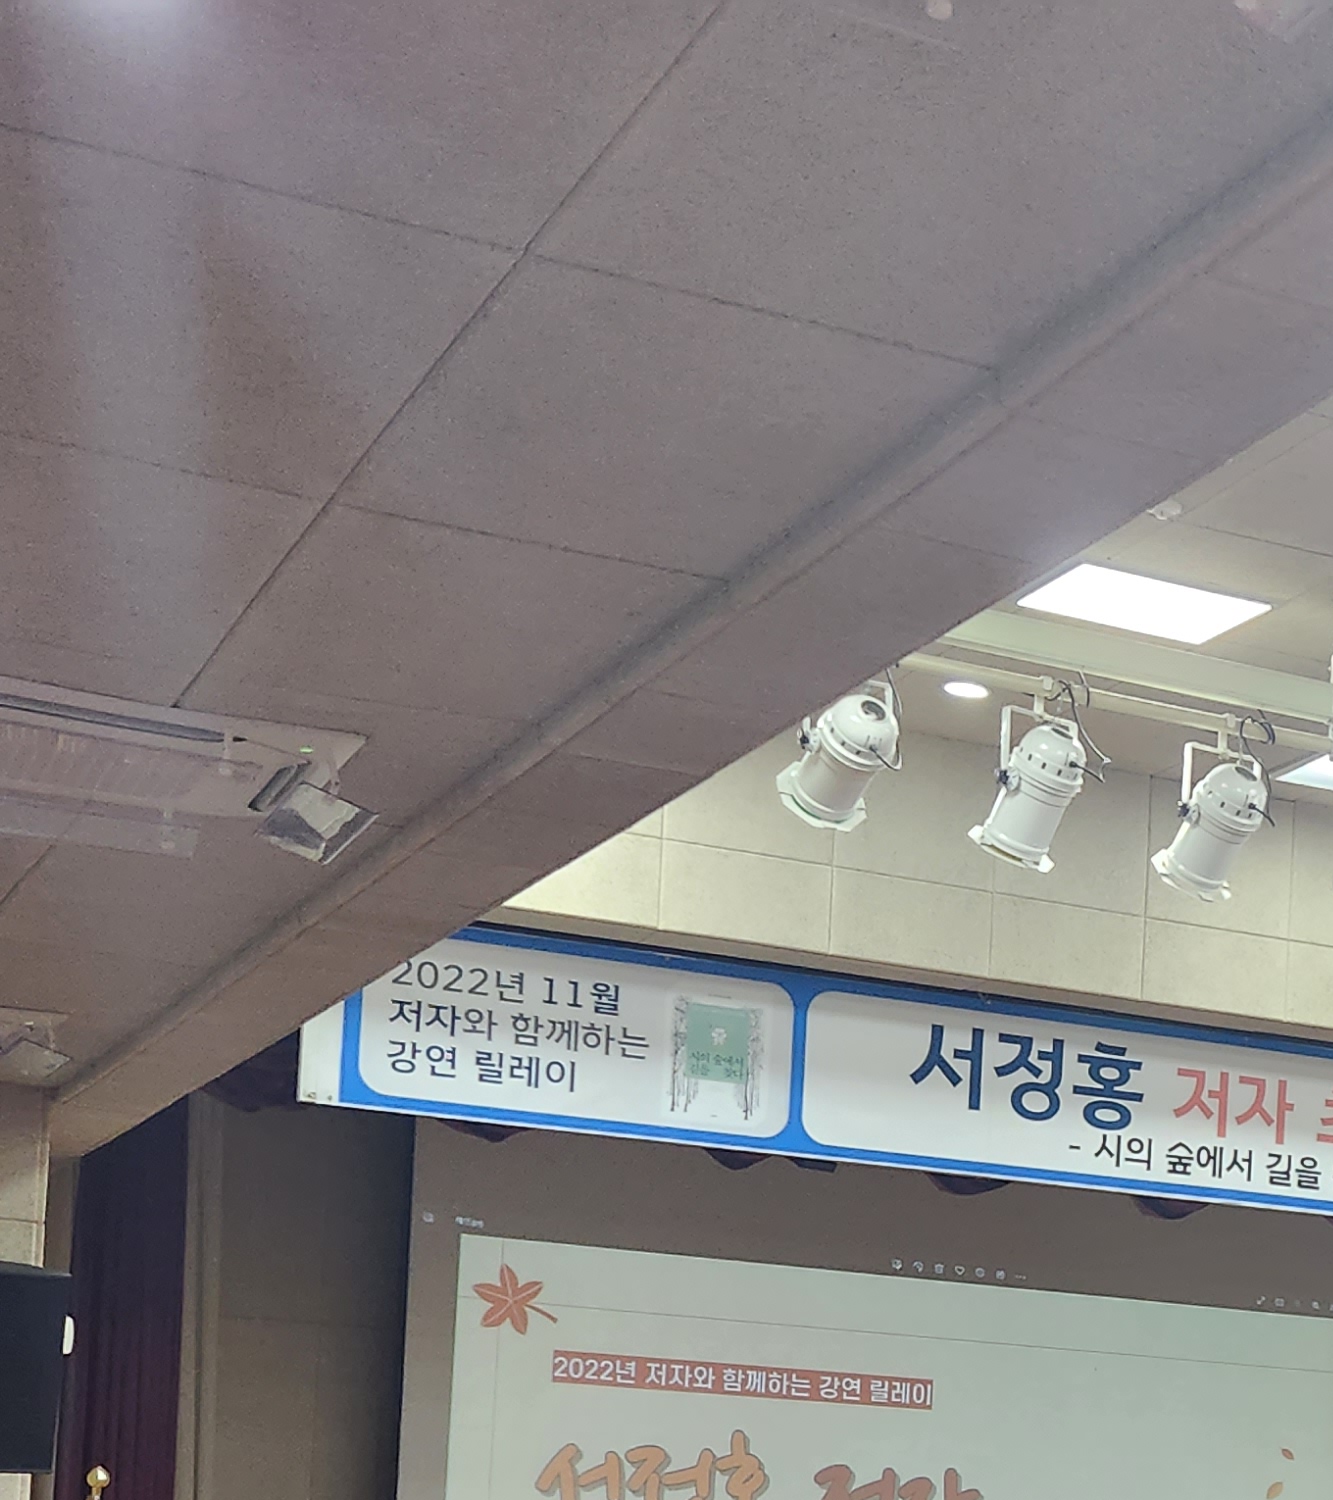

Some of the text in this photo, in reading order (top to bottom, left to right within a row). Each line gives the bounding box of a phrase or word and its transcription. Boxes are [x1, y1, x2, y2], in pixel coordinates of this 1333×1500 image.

[391, 959, 620, 1017] 2022년 11월
[388, 998, 650, 1060] 저자와 함께하는
[386, 1040, 577, 1093] 강연 릴레이
[909, 1024, 1145, 1131] 서정홍
[1172, 1067, 1295, 1146] 저자
[1094, 1133, 1153, 1171] 시의
[1165, 1141, 1253, 1182] 숲에서
[1265, 1152, 1322, 1191] 길을
[553, 1356, 932, 1406] 2022년 저자와 함께하는 강연 릴레이
